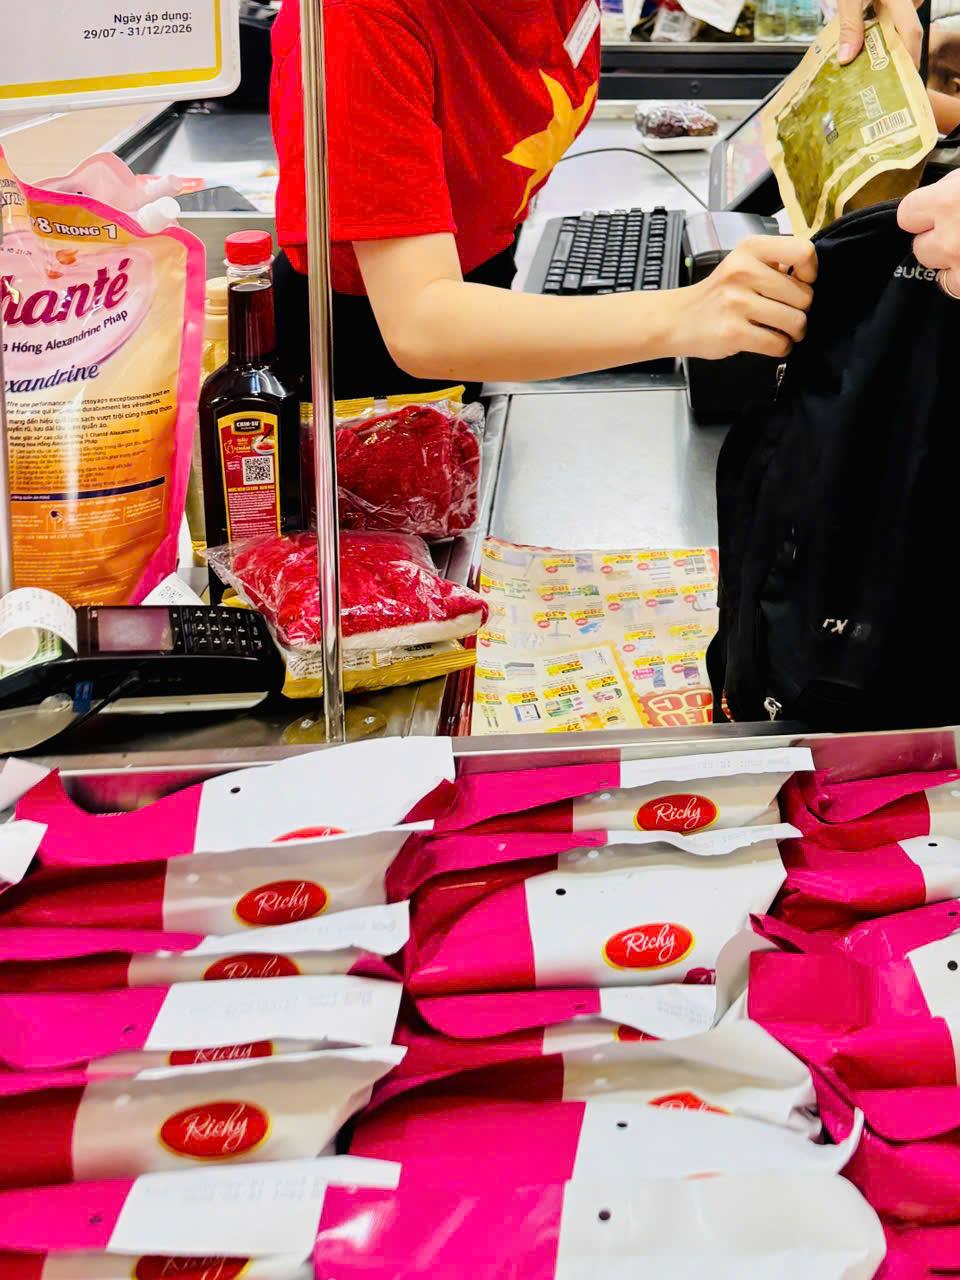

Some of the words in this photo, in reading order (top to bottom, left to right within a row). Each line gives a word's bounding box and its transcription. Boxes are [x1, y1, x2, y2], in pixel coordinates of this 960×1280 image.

[83, 28, 117, 39] 29/07
[127, 24, 193, 36] 31/12/2026
[113, 13, 142, 24] Ngày
[145, 12, 159, 23] áp
[161, 11, 192, 23] dụng:
[36, 216, 53, 234] 8
[53, 222, 101, 236] TRONG
[102, 223, 117, 239] 1
[45, 324, 102, 351] Alexandrine
[5, 364, 100, 393] xandrine
[653, 797, 701, 829] Richy
[255, 881, 310, 919] Richy
[622, 924, 676, 962] Richy
[183, 1104, 248, 1152] Richy
